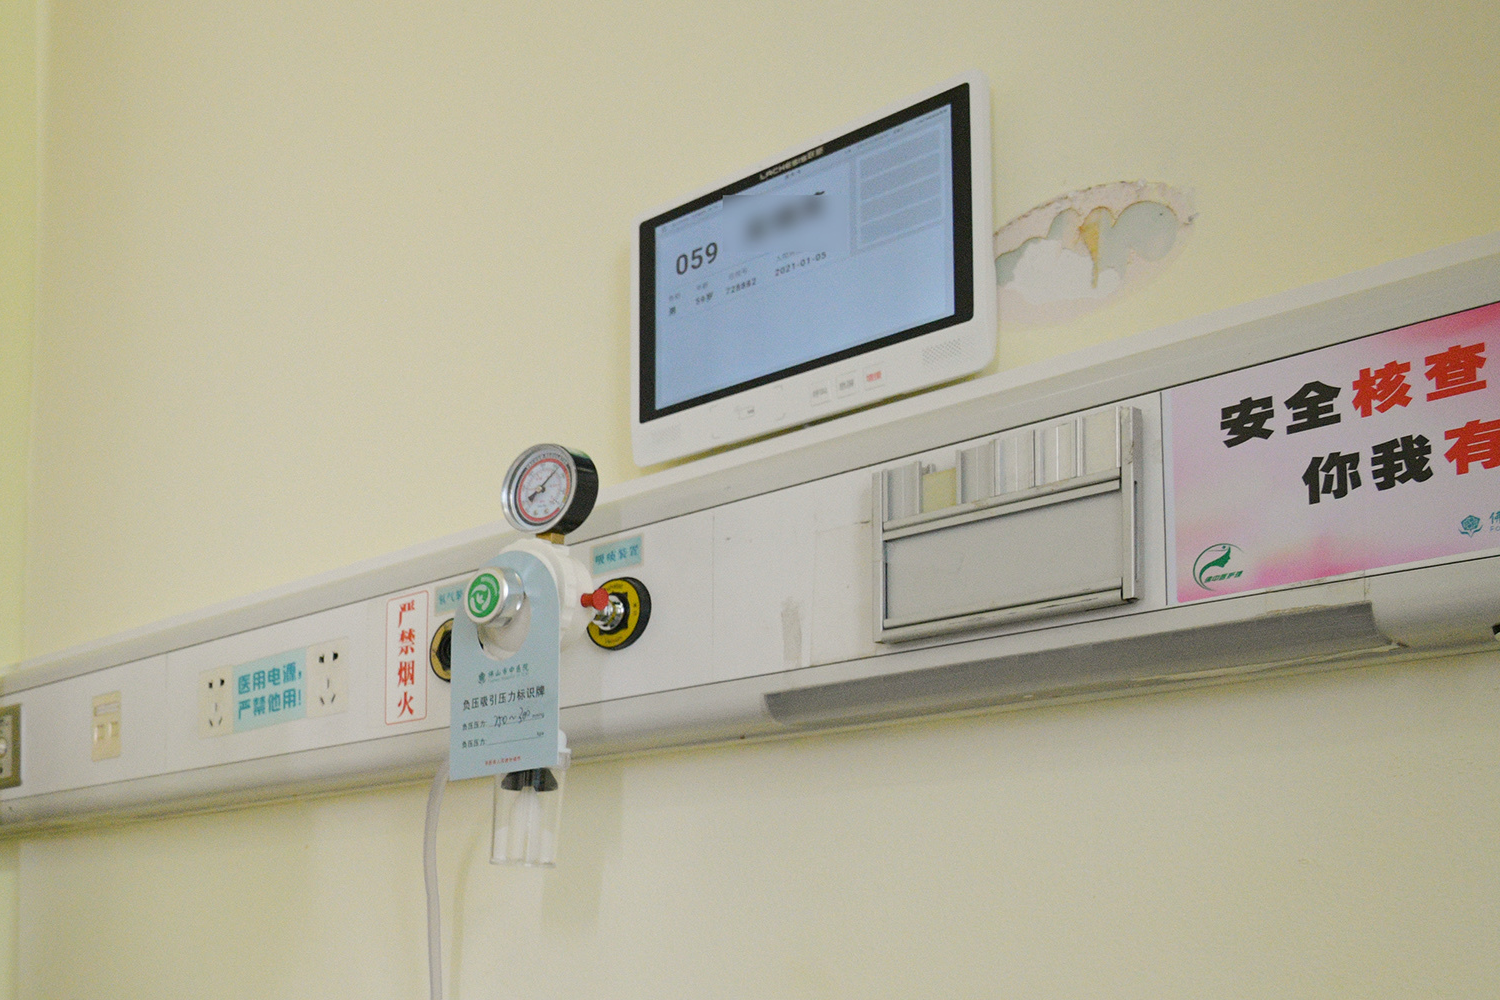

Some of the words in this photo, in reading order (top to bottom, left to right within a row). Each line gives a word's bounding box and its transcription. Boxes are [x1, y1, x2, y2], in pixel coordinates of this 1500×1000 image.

[676, 242, 718, 275] 059
[775, 251, 827, 277] 2021-01-05
[1220, 341, 1488, 449] 安全核查
[1301, 419, 1500, 505] 你我有
[397, 600, 416, 718] 严禁烟火
[463, 685, 545, 711] 负压吸引压力标识牌
